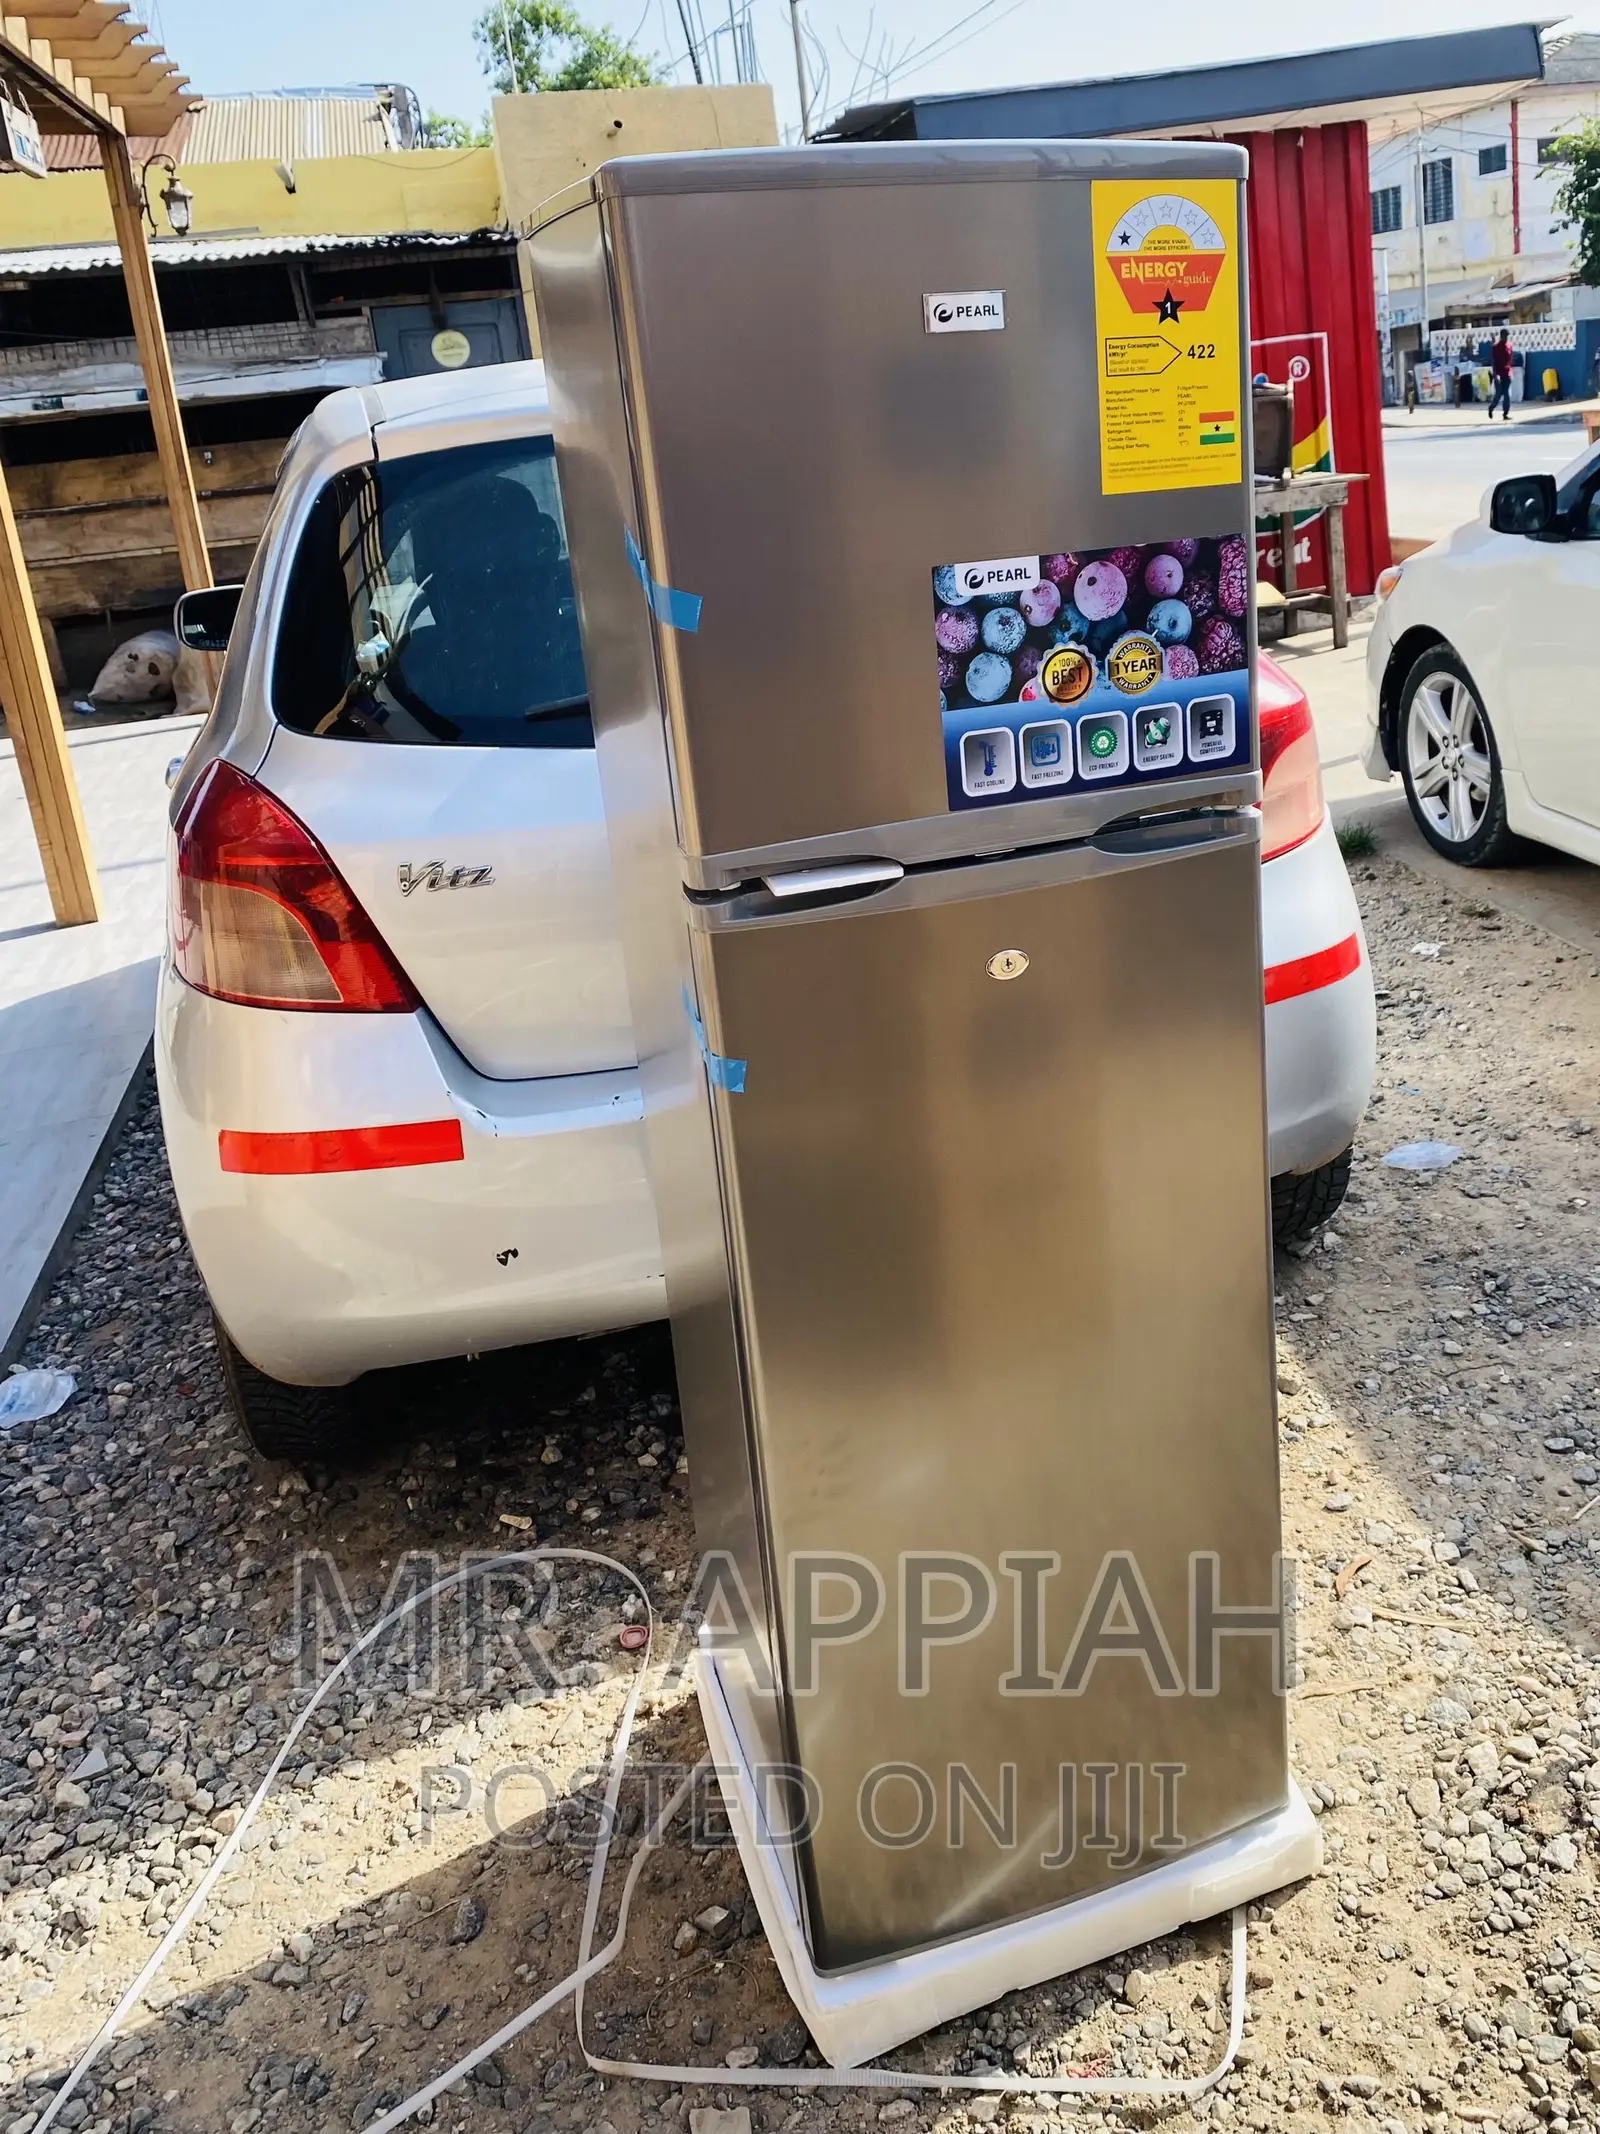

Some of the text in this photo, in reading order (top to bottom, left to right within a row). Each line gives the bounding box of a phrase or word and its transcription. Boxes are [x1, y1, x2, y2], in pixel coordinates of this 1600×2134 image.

[1121, 257, 1187, 284] ENERGY
[1183, 271, 1212, 287] guide
[956, 304, 999, 318] PEARL
[1165, 301, 1171, 314] 1
[1187, 344, 1215, 359] 422
[987, 567, 1032, 584] PEARL
[1118, 642, 1153, 658] WARRANTY
[1058, 657, 1077, 668] 100%
[1114, 658, 1157, 675] 1 YEAR
[1051, 666, 1084, 686] BEST
[1118, 673, 1154, 689] WARRANTY
[1143, 752, 1175, 763] ENERGY SAVING
[1031, 769, 1064, 780] FAST FREEZING
[974, 778, 1006, 789] FAST COOLING
[397, 858, 496, 897] Vitz
